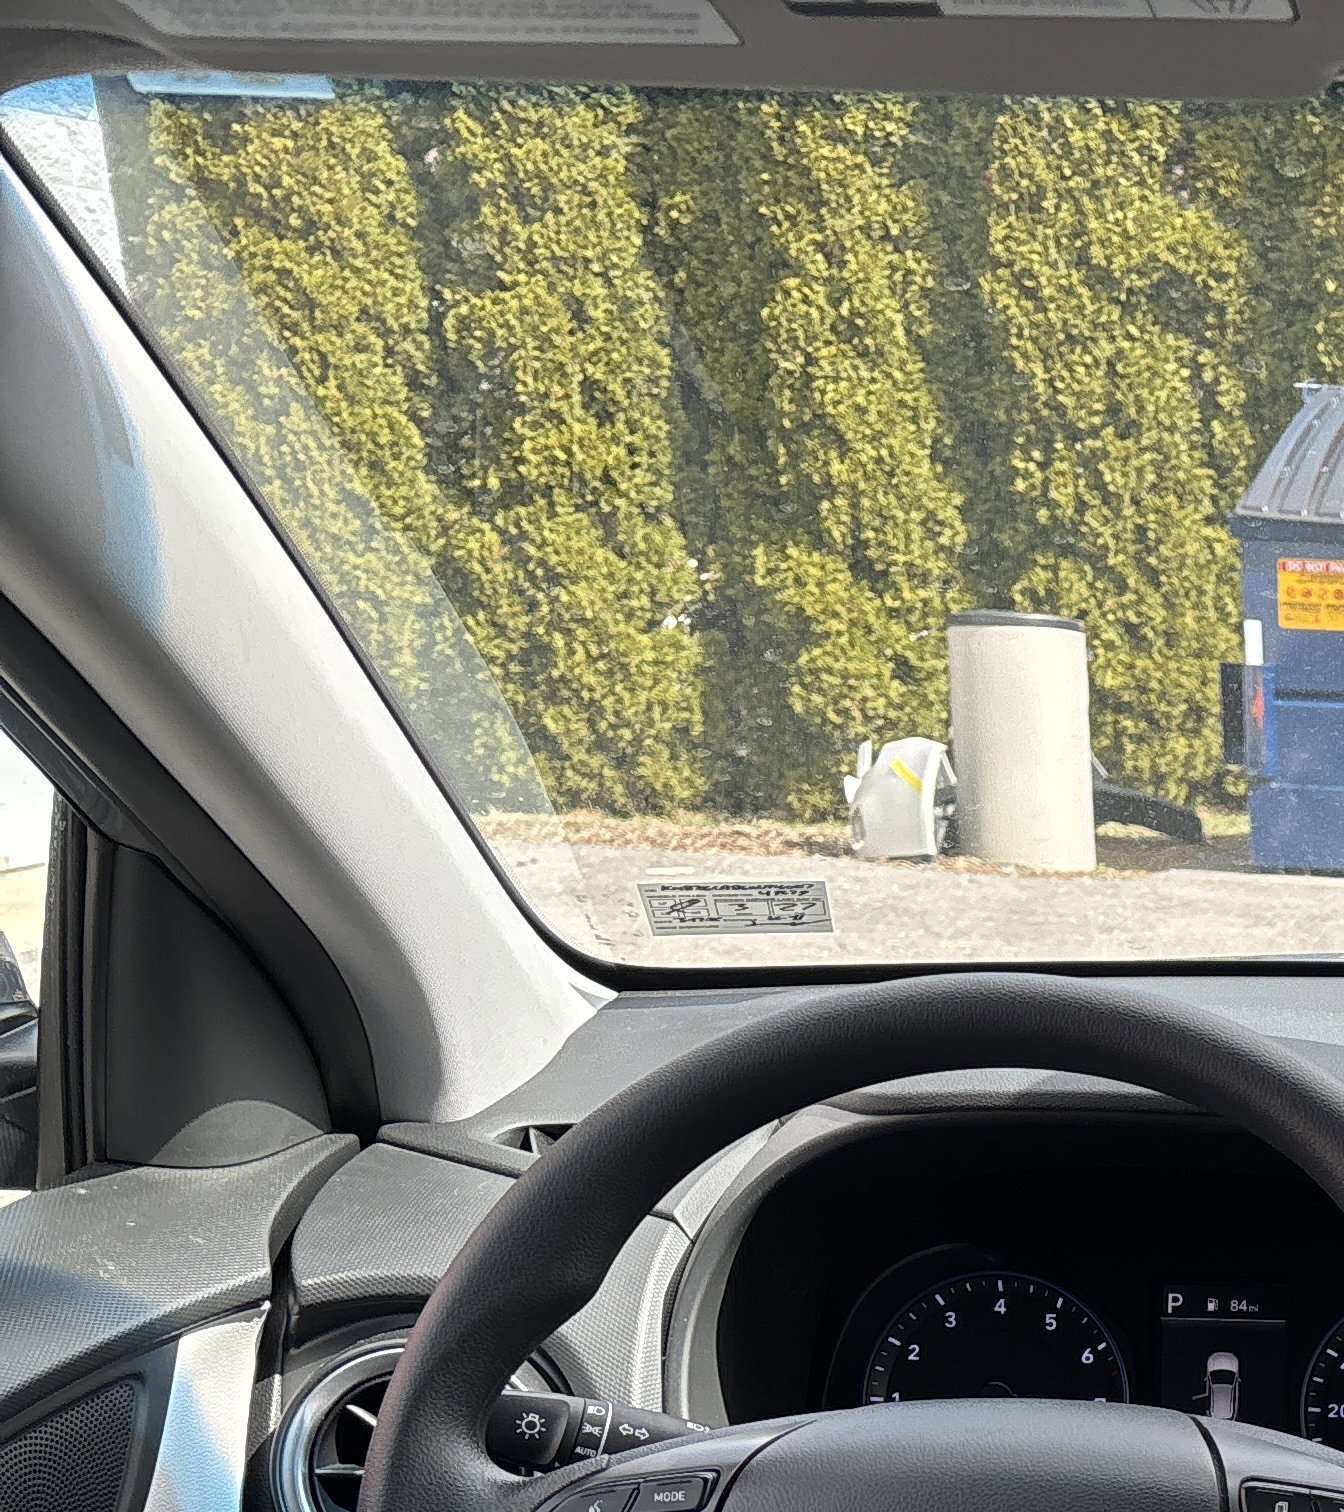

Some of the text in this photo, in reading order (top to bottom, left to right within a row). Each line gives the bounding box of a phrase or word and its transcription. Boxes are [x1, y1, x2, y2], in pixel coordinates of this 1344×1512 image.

[994, 1299, 1006, 1315] 4
[1167, 1293, 1183, 1314] P
[945, 1312, 957, 1328] 3
[1045, 1314, 1057, 1330] 5
[907, 1344, 920, 1361] 2
[1081, 1348, 1094, 1364] 6
[575, 1446, 597, 1458] AUTO
[654, 1491, 686, 1502] MODE
